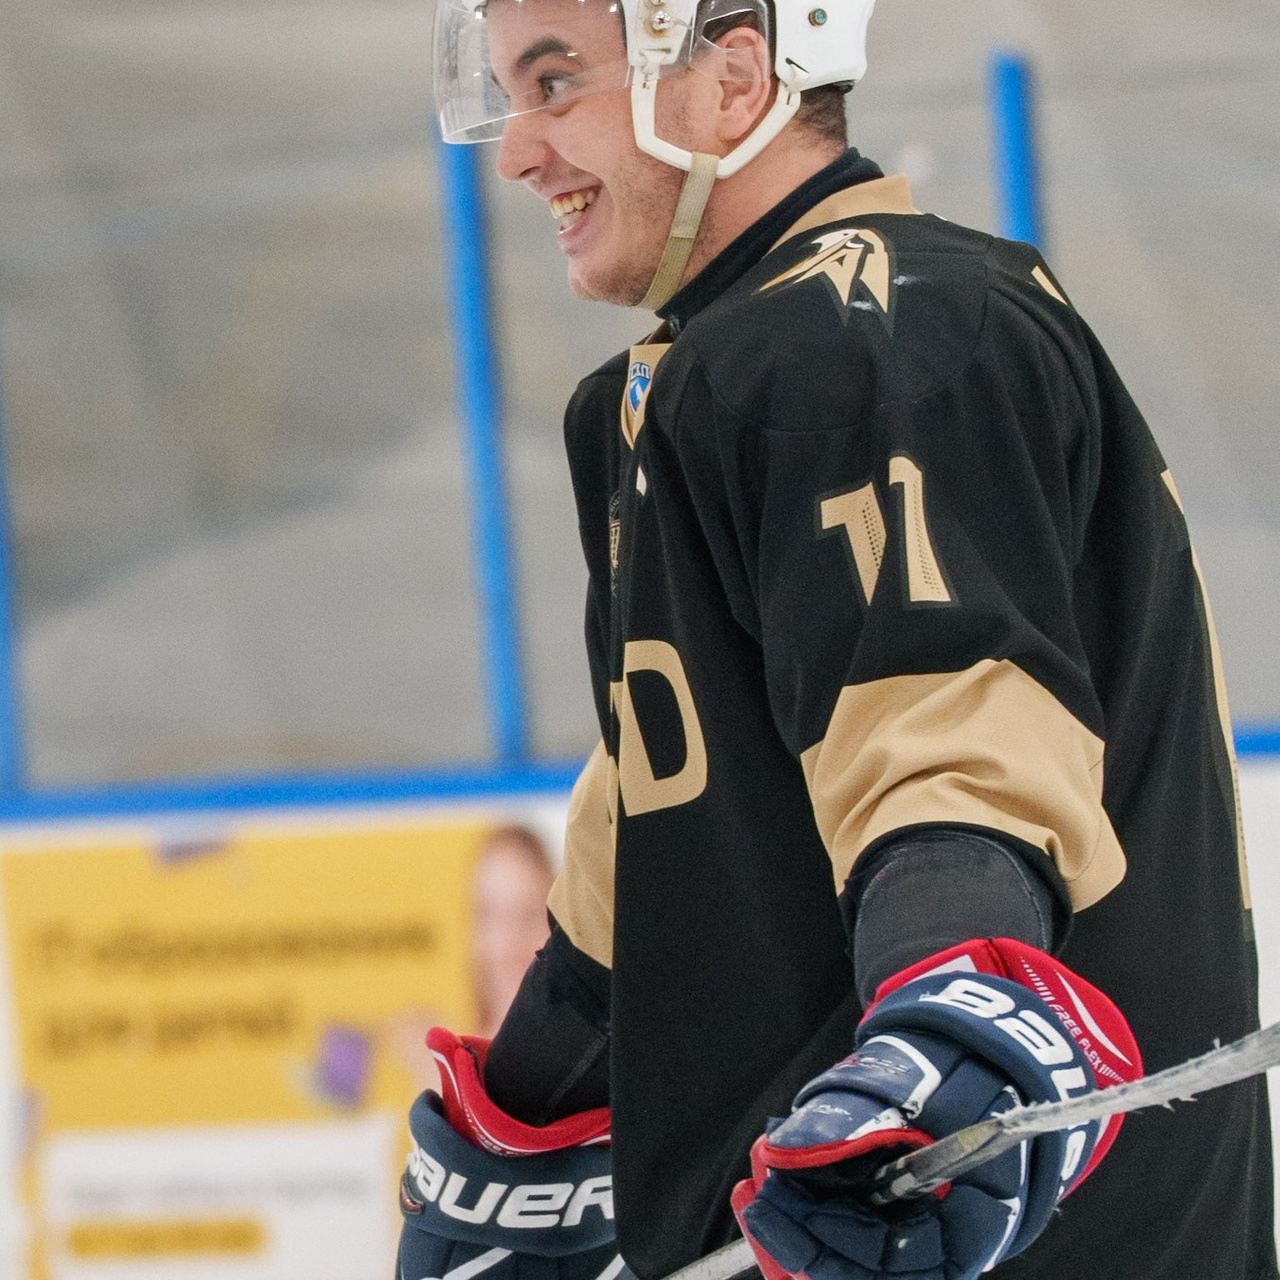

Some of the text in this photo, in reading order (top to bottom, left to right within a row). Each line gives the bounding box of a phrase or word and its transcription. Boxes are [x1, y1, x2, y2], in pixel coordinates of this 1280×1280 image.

[610, 639, 708, 818] D
[1048, 1003, 1102, 1070] FREE FLEX
